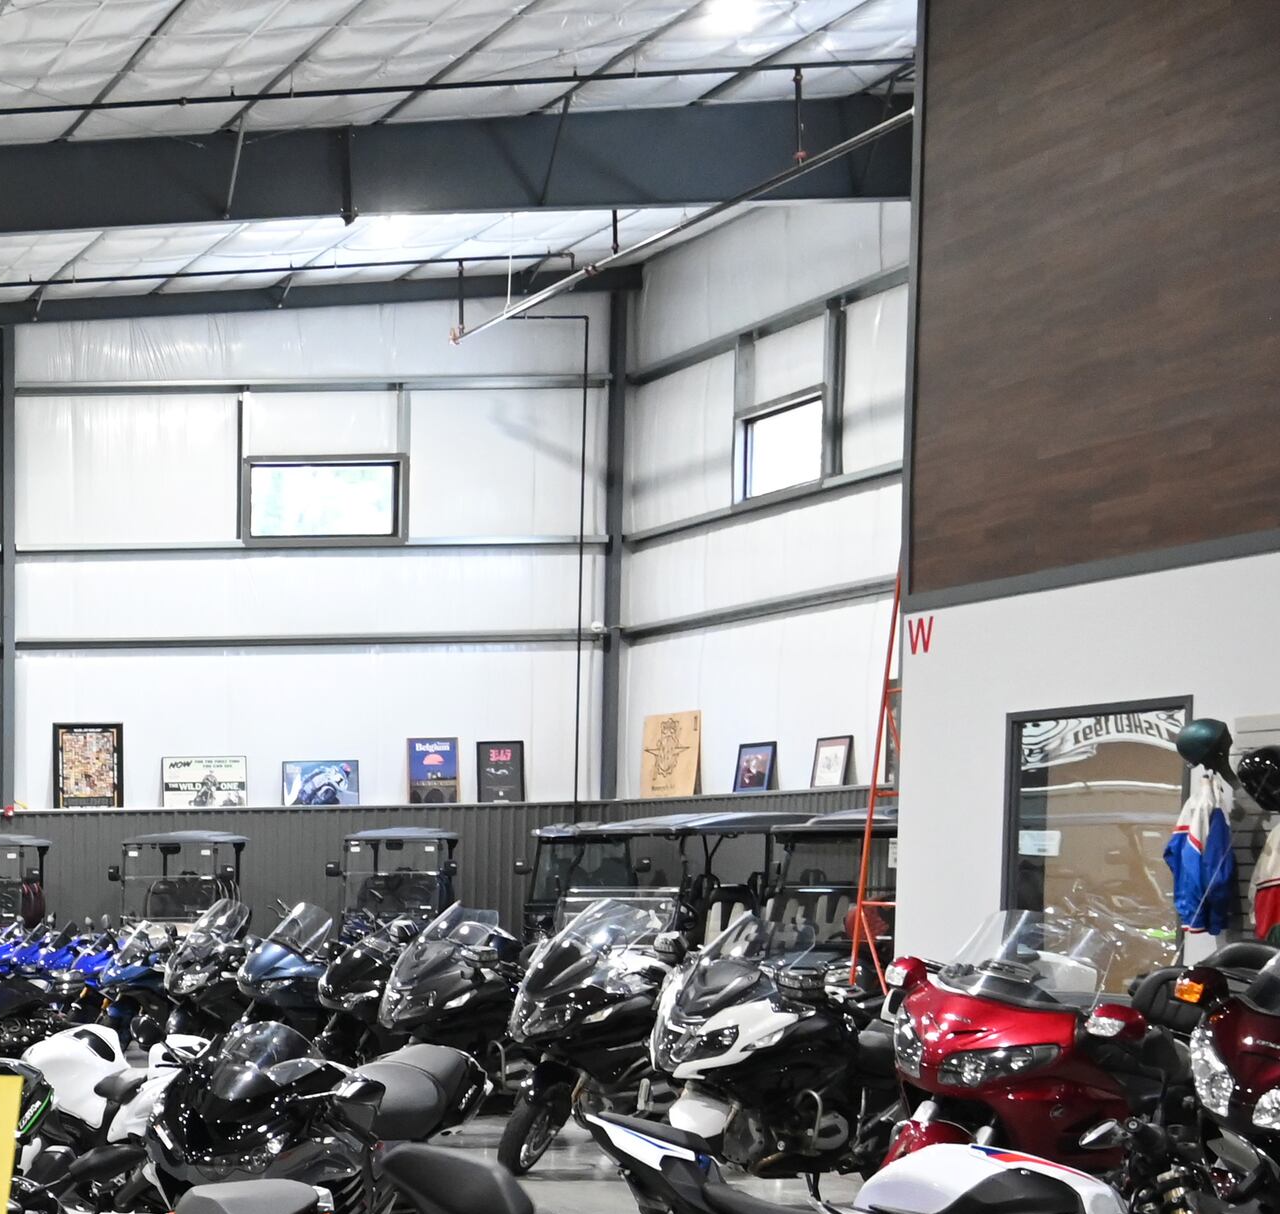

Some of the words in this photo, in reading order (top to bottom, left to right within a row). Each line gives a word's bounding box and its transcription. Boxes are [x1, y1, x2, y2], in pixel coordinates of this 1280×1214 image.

[907, 617, 934, 655] W
[168, 760, 192, 769] NOW
[179, 783, 202, 791] WILD
[220, 782, 239, 790] ONE
